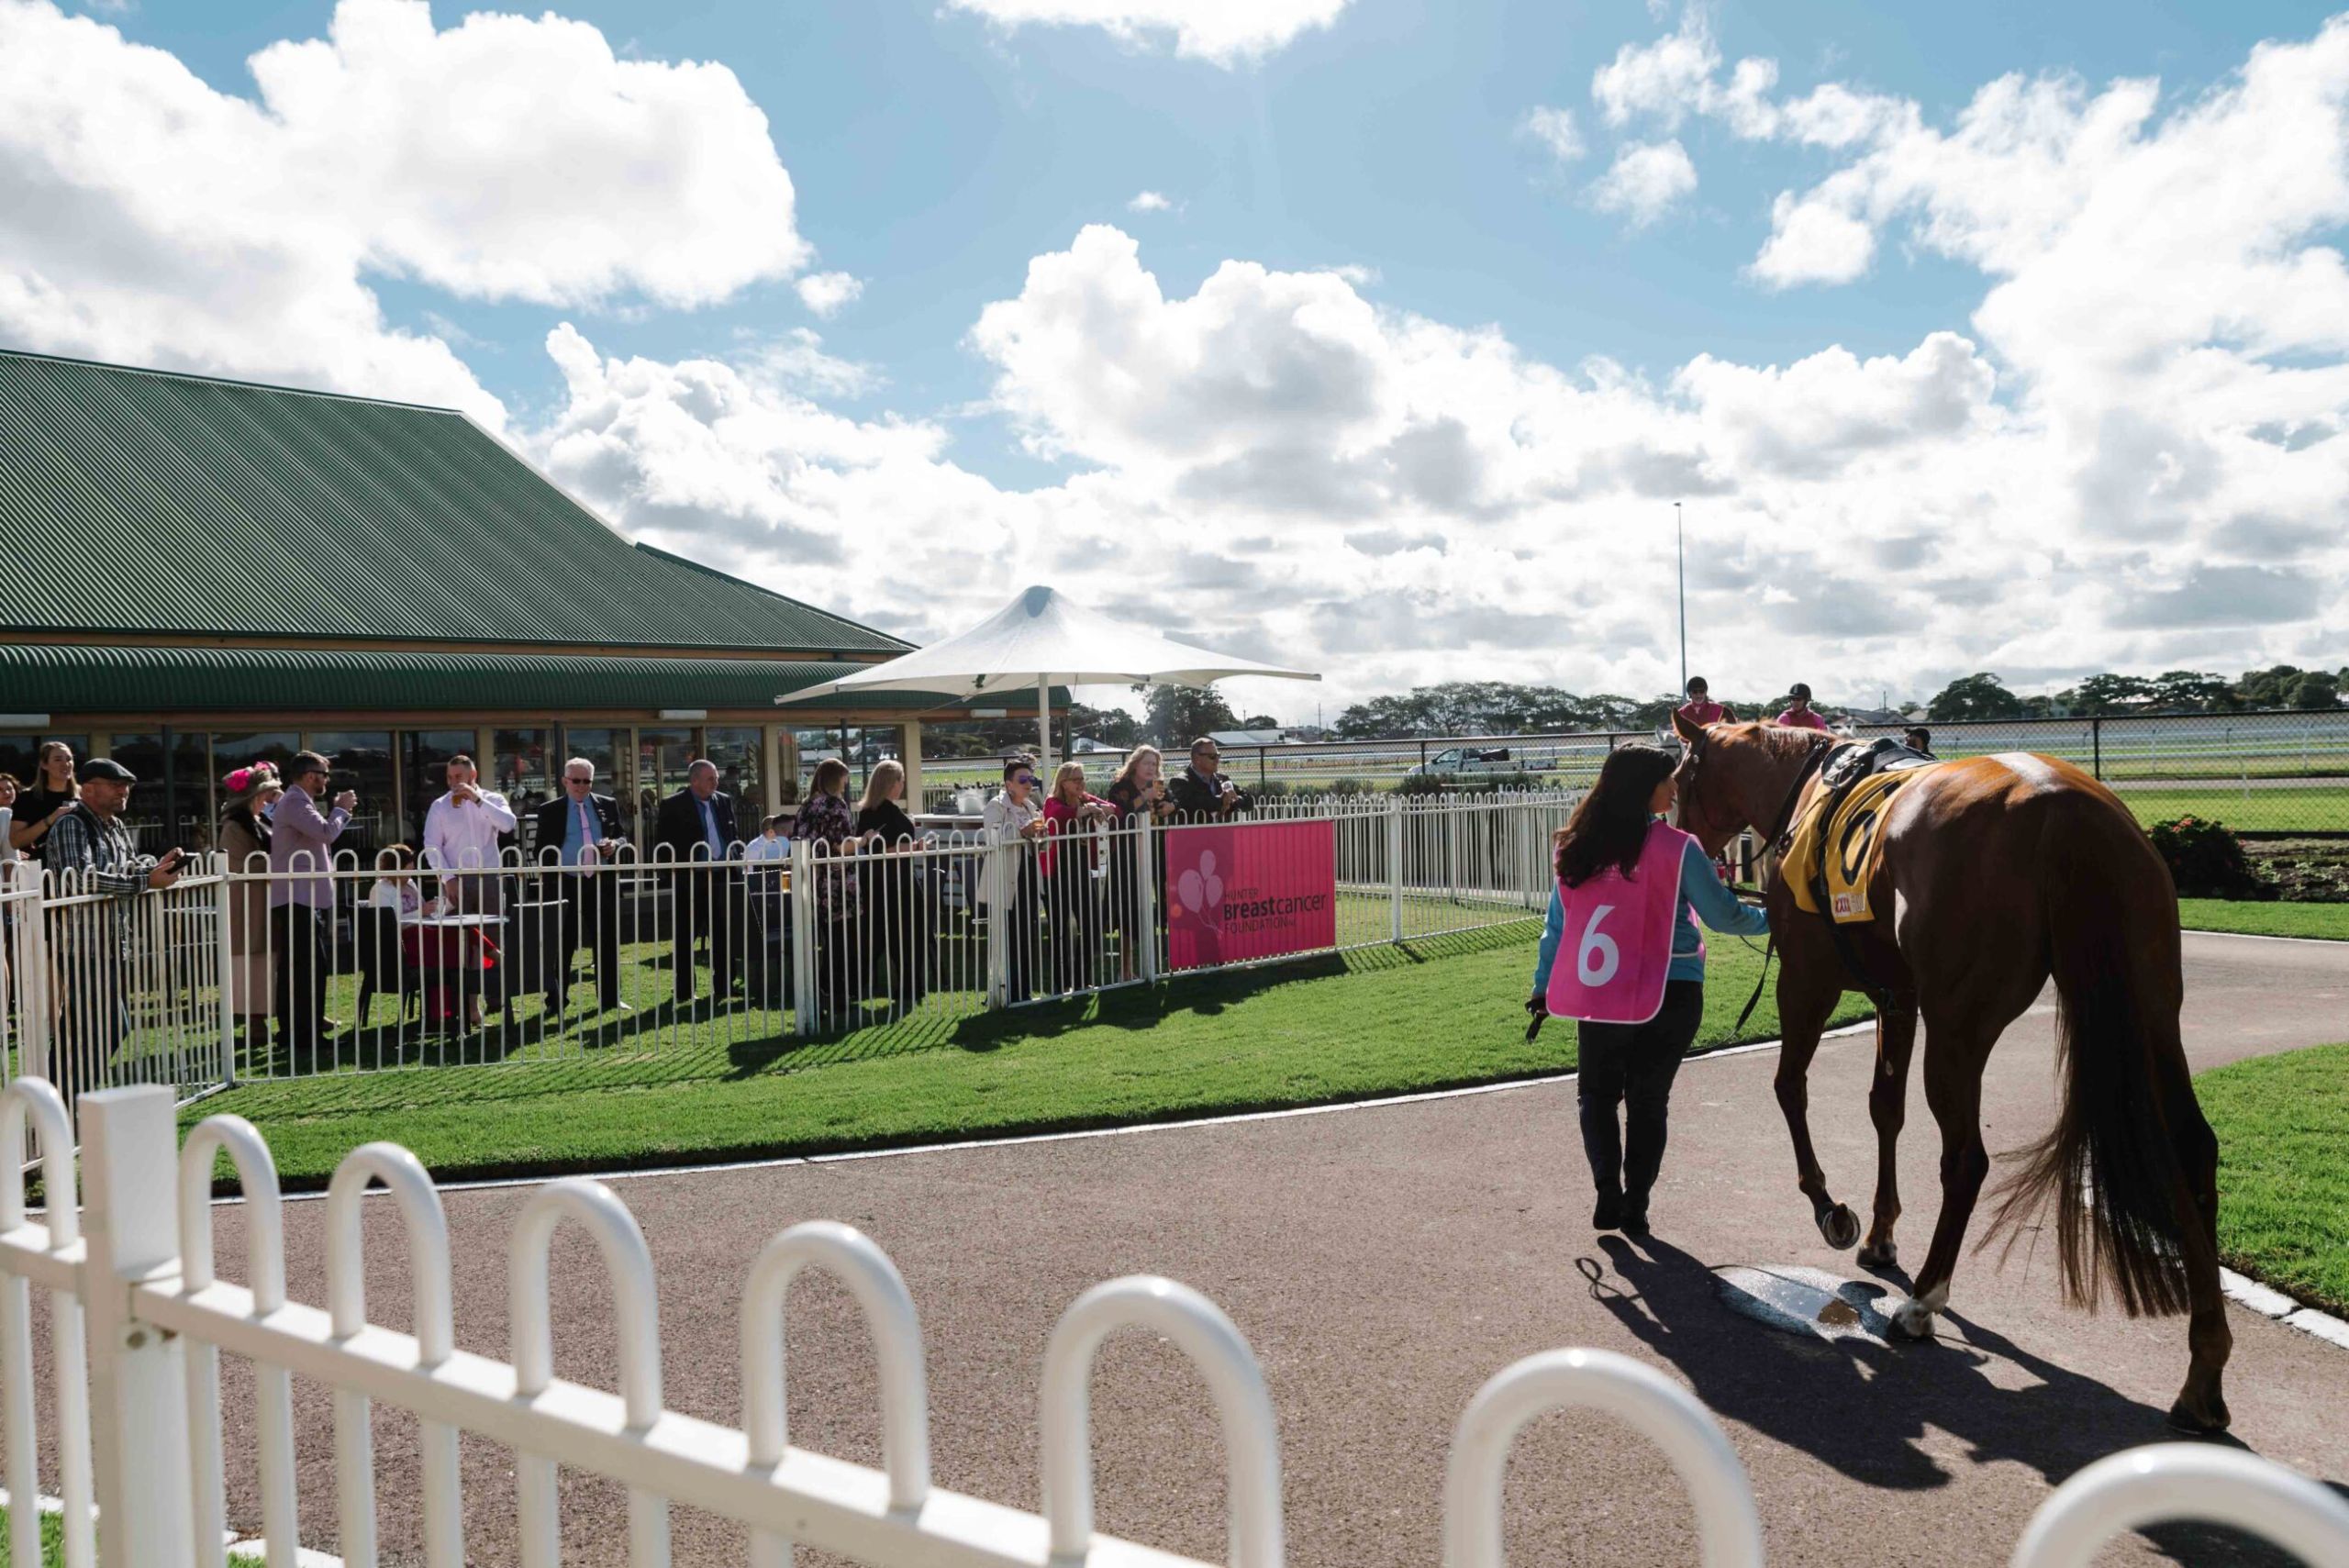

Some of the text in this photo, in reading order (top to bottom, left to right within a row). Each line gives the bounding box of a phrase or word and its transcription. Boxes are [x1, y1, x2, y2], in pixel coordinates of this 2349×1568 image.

[1224, 887, 1259, 899] HUNTER
[1224, 917, 1288, 934] FOUNDATION
[1577, 905, 1620, 987] 6
